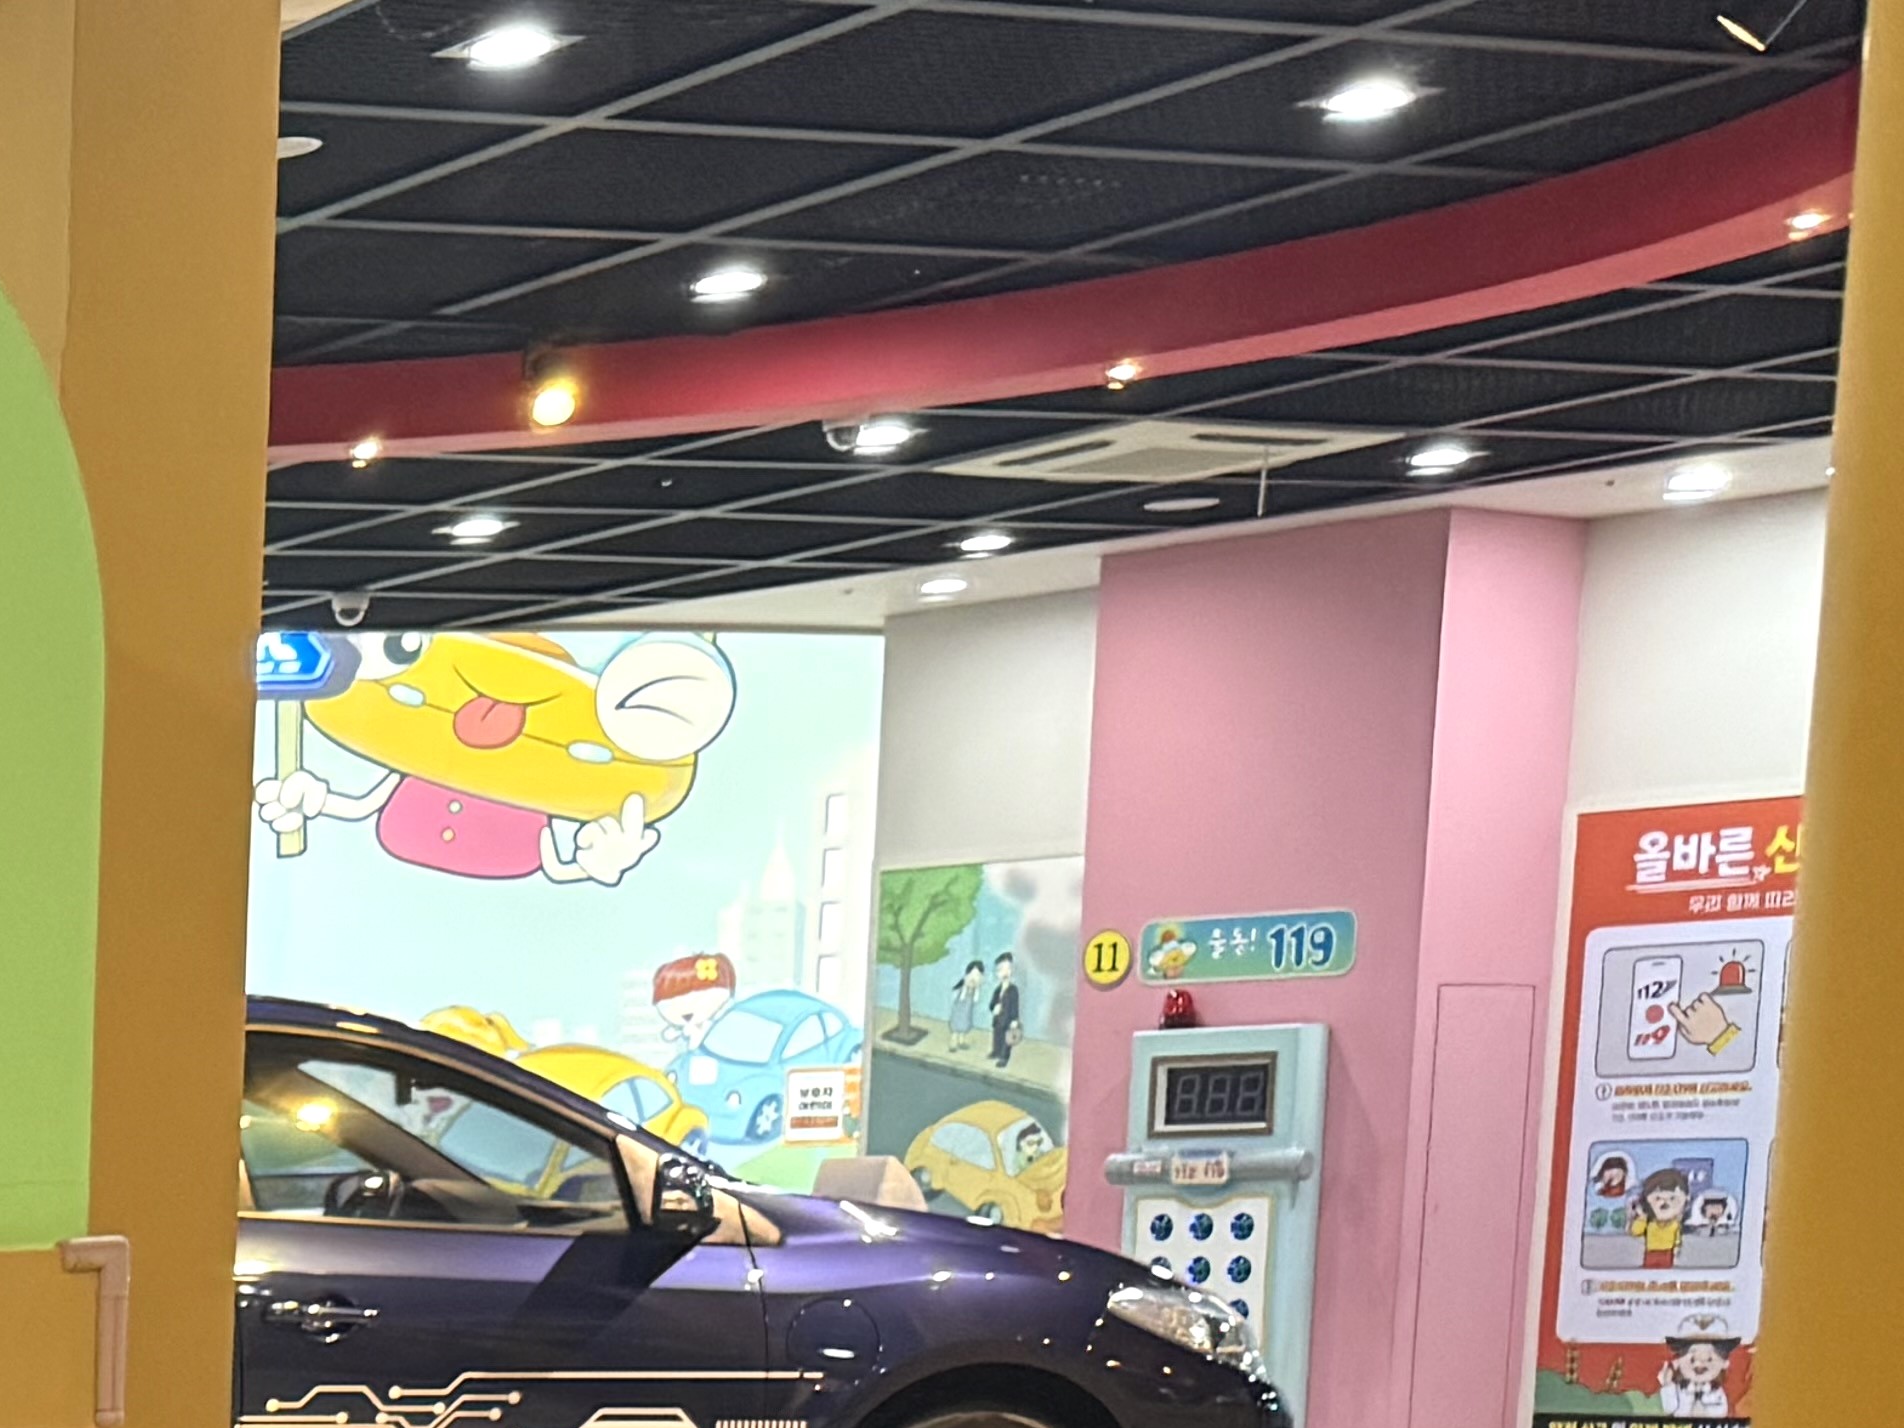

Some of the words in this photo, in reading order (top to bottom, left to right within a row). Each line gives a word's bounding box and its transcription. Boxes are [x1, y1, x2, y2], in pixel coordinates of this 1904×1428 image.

[1633, 826, 1755, 884] 올바른
[1092, 941, 1120, 973] 11
[1268, 922, 1337, 971] 119
